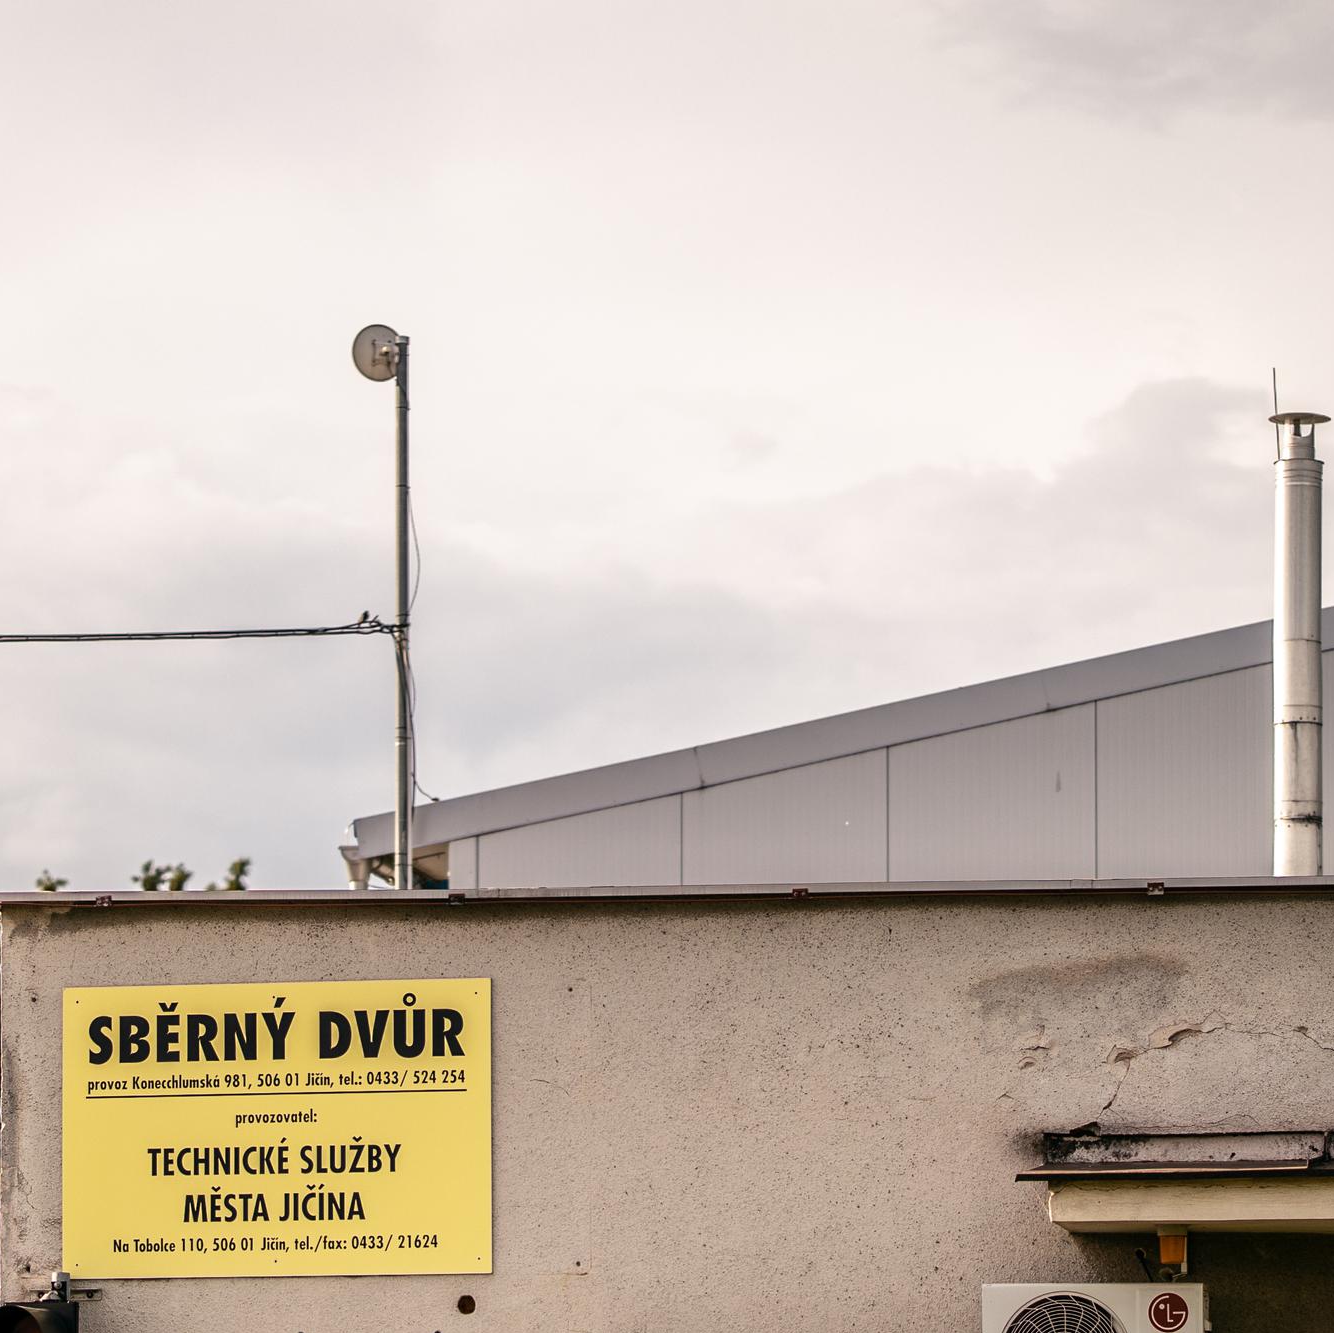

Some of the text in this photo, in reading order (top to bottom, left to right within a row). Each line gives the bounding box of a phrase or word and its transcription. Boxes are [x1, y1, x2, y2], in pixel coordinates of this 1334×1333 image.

[88, 993, 466, 1065] SBĚRNÝ DVŮR
[87, 1069, 465, 1094] provoz Konecchlumská 981, 506 01 Jičín, tel.: 0433/ 524 254
[235, 1108, 318, 1128] provozovatel:
[147, 1136, 402, 1176] TECHNICKÉ SLUŽBY
[183, 1183, 366, 1223] MĚSTA JIČÍNA
[113, 1234, 438, 1254] Na Tobolce 110, 506 01 Jičín, tel./fax: 0433/ 21624
